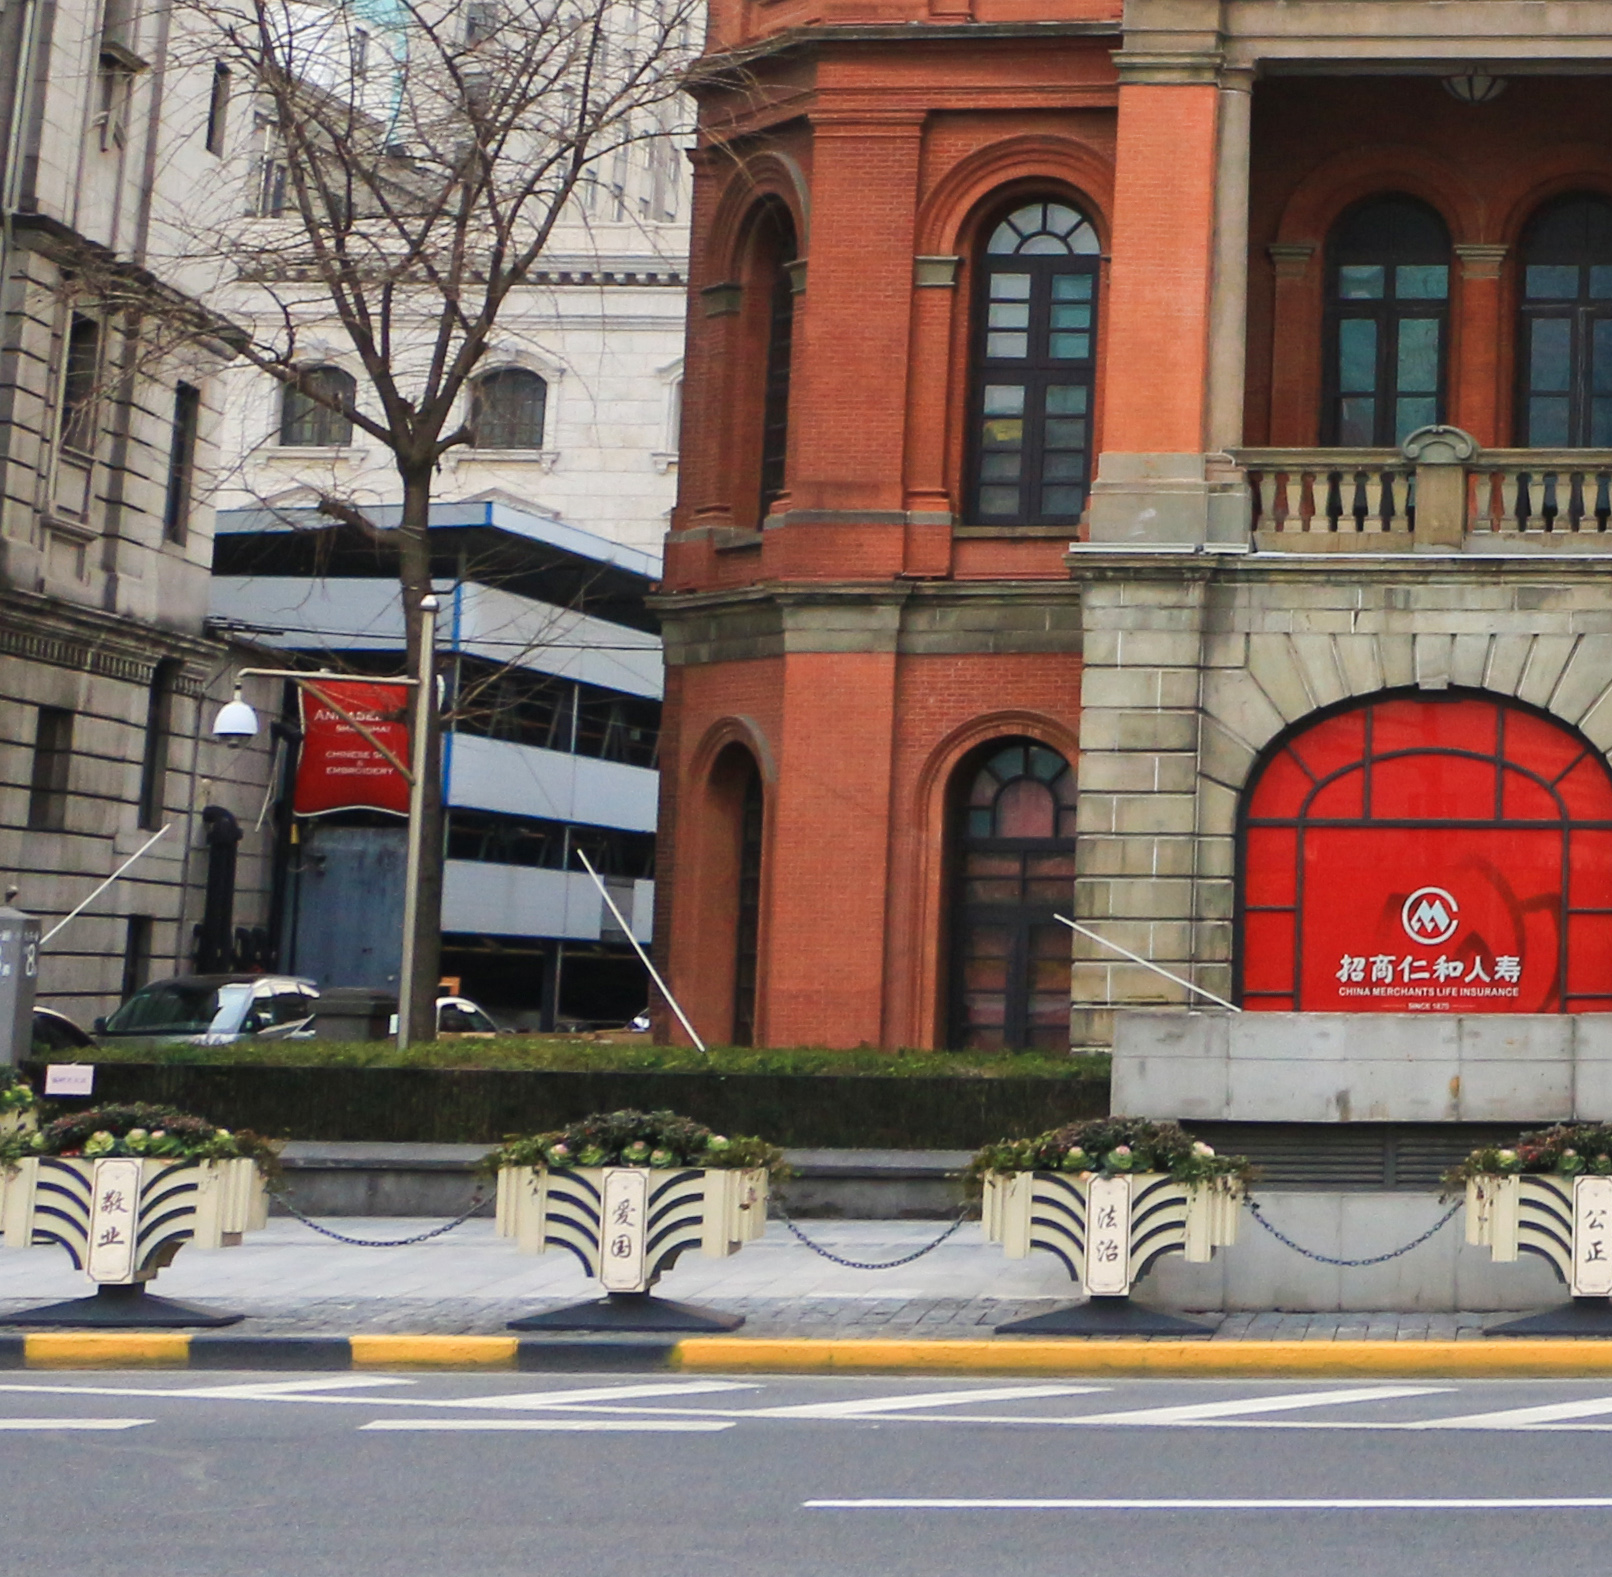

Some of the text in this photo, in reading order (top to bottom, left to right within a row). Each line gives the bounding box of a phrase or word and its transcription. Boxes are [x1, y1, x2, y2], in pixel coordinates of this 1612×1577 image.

[1335, 954, 1522, 984] 招商仁和人寿
[1338, 986, 1520, 997] CHINA MERCHANTS LIFE INSURANCE
[98, 1191, 128, 1247] 敬业
[610, 1198, 636, 1259] 爱国
[1096, 1205, 1119, 1262] 法治
[1584, 1209, 1608, 1263] 公正
